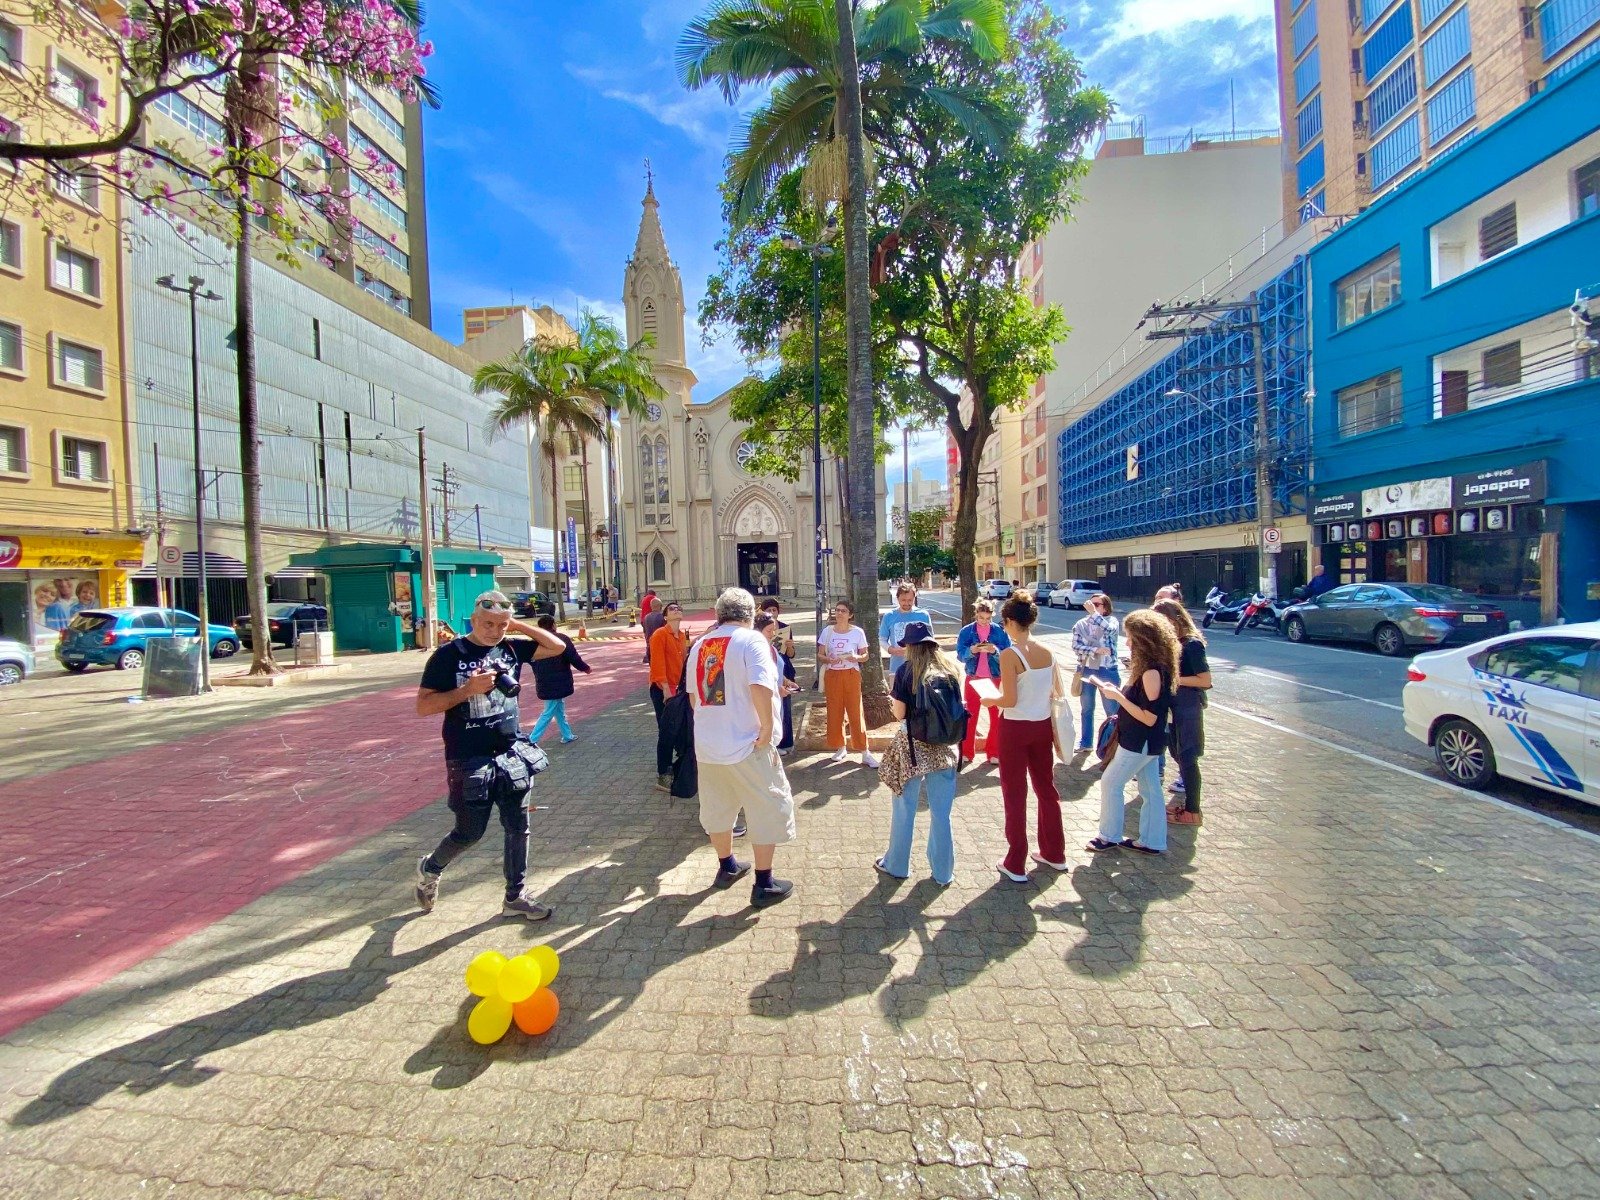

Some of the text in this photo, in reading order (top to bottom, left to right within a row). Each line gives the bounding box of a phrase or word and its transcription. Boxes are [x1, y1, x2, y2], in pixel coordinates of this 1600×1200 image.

[1463, 478, 1530, 496] japapop
[766, 483, 776, 492] DO
[776, 491, 795, 515] CARMO
[1313, 501, 1355, 515] japapop
[1487, 703, 1528, 725] TAXI
